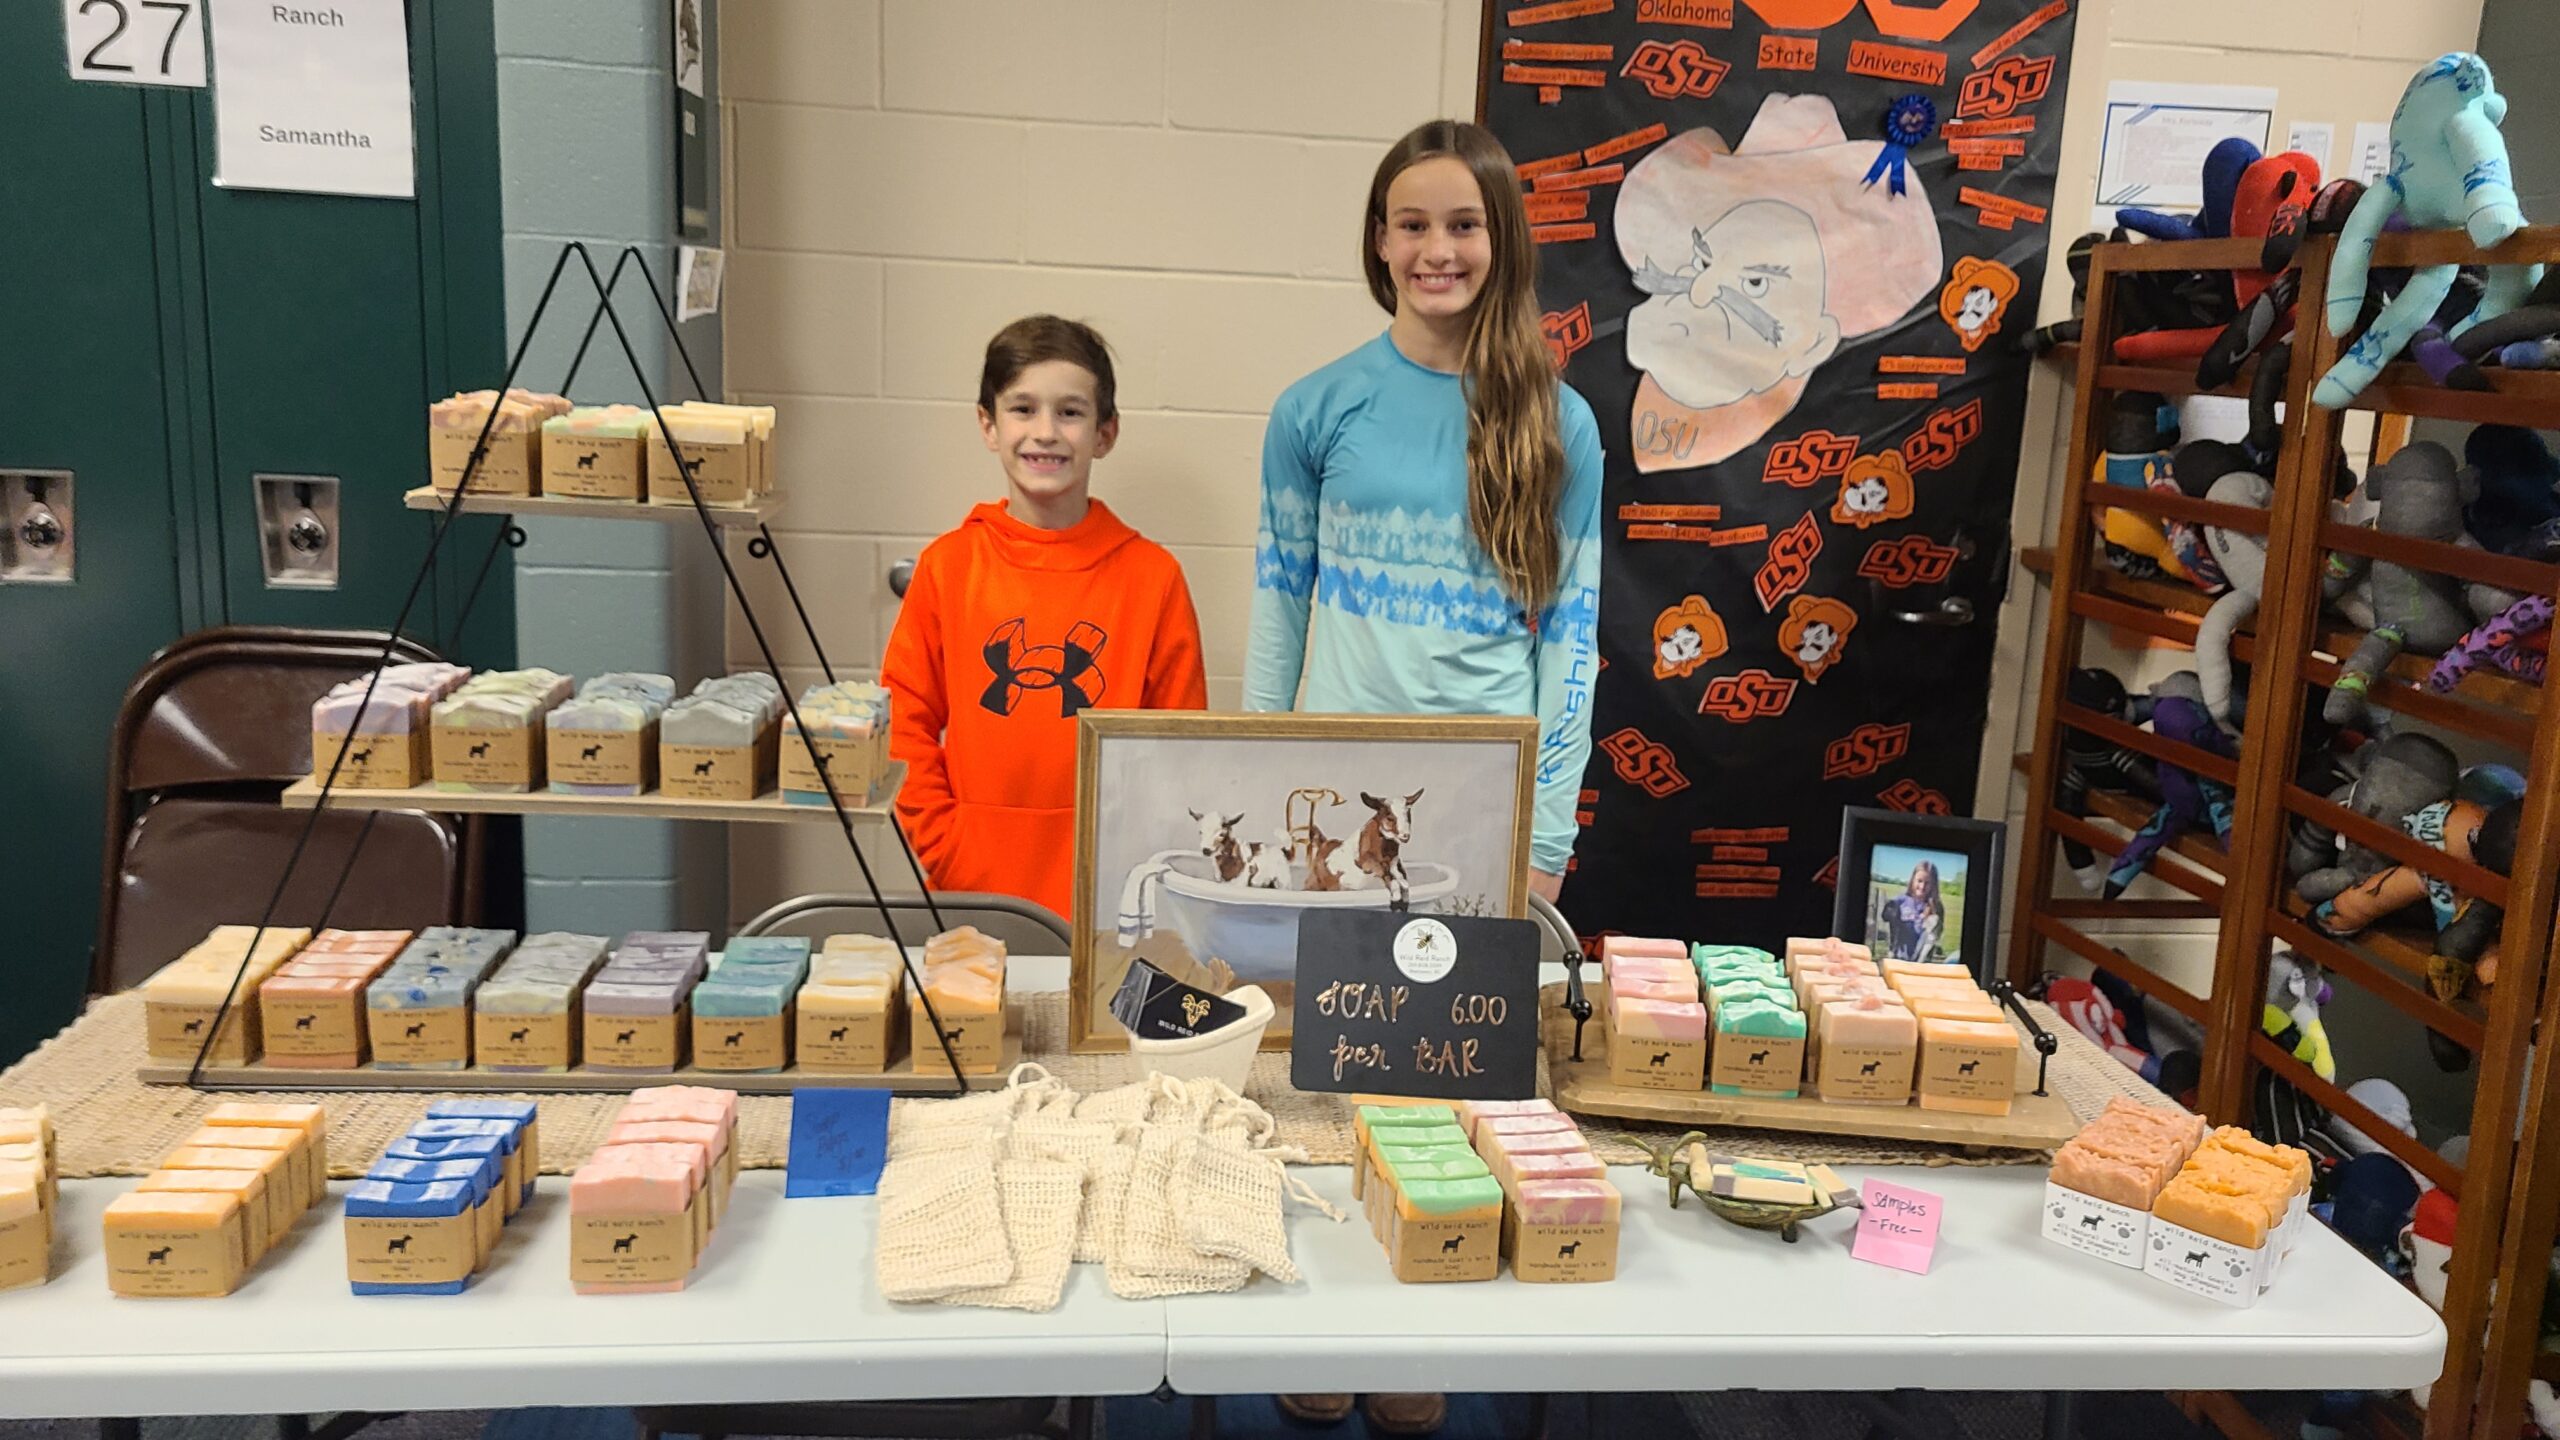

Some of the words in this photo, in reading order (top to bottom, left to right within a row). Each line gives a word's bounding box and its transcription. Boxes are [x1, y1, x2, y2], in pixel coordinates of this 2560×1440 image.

[79, 0, 192, 75] 27
[272, 6, 344, 27] Ranch
[1639, 0, 1731, 23] Oklahoma
[1622, 42, 1730, 97] OSU
[1760, 44, 1815, 65] State
[1850, 49, 1945, 85] University
[1960, 56, 2052, 116] OSU
[259, 125, 372, 149] Samantha
[1540, 305, 1591, 369] SU
[1636, 411, 1700, 460] OSU
[1764, 431, 1858, 485] OSU
[1903, 401, 1979, 471] OSU
[1756, 513, 1822, 608] OSU
[1859, 536, 1957, 588] OSU
[1701, 671, 1797, 721] OSU
[1601, 729, 1690, 797] OSU
[1825, 724, 1909, 779] OSU
[1315, 979, 1410, 1024] SOAP
[1450, 992, 1508, 1027] 6.00
[1329, 1033, 1392, 1083] per
[1412, 1035, 1486, 1078] BAR
